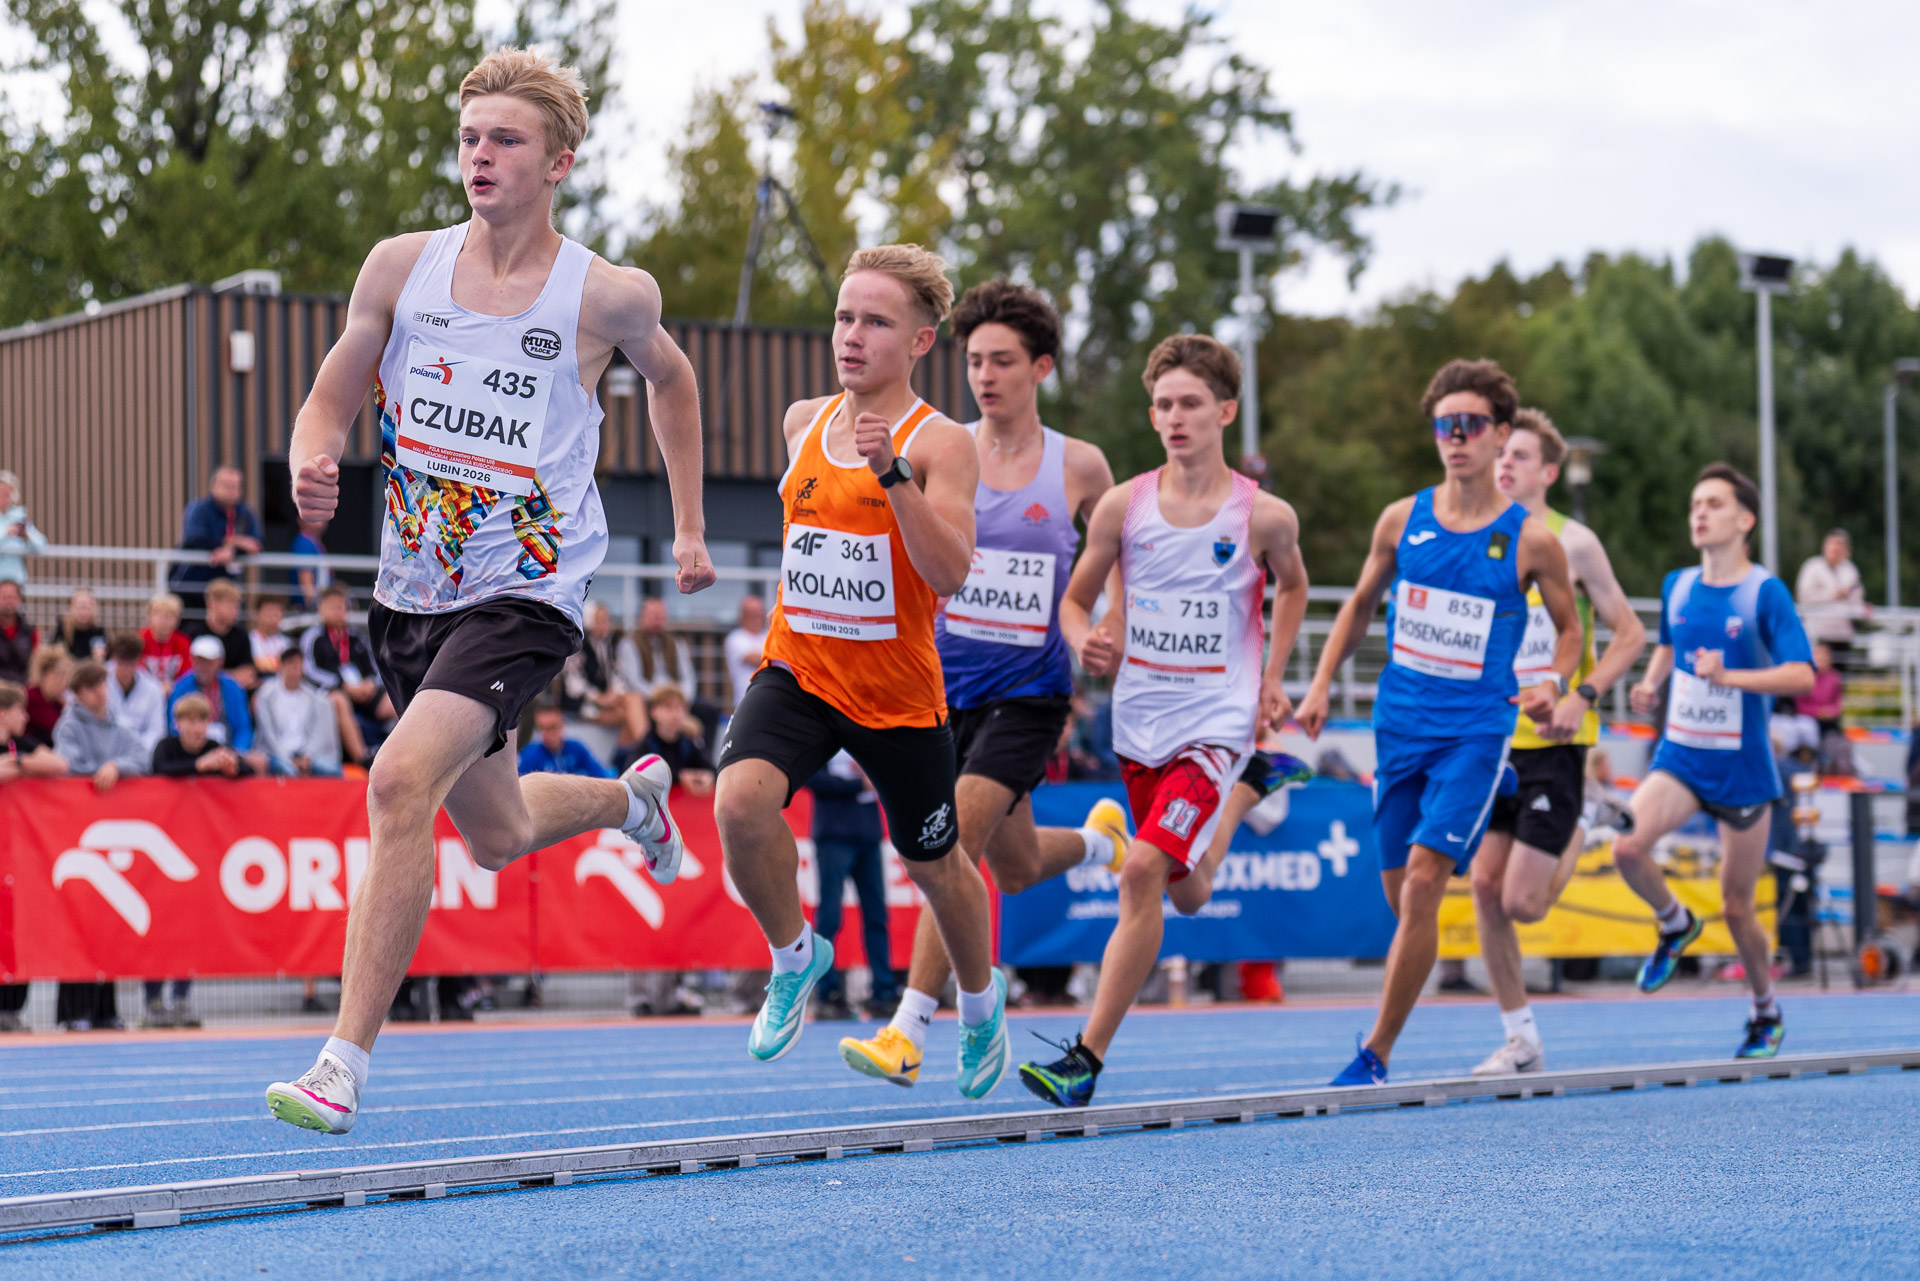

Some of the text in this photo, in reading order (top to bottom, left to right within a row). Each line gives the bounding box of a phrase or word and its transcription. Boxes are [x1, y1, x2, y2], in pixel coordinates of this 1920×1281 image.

[524, 335, 561, 351] MUKS
[409, 365, 442, 382] polanik
[482, 369, 538, 399] 435
[410, 397, 532, 449] CZUBAK
[427, 460, 491, 483] LUBIN 2026
[791, 531, 828, 556] 4F
[840, 539, 878, 562] 361
[1007, 558, 1045, 577] 212
[787, 569, 886, 603] KOLANO
[955, 585, 1042, 613] KAPAŁA
[1179, 599, 1219, 619] 713
[1447, 599, 1484, 620] 853
[811, 622, 860, 636] LUBIN 2026
[1131, 625, 1223, 654] MAZIARZ
[1399, 617, 1482, 651] ROSENGART
[1678, 703, 1728, 724] GAJOS
[1158, 798, 1201, 840] 11
